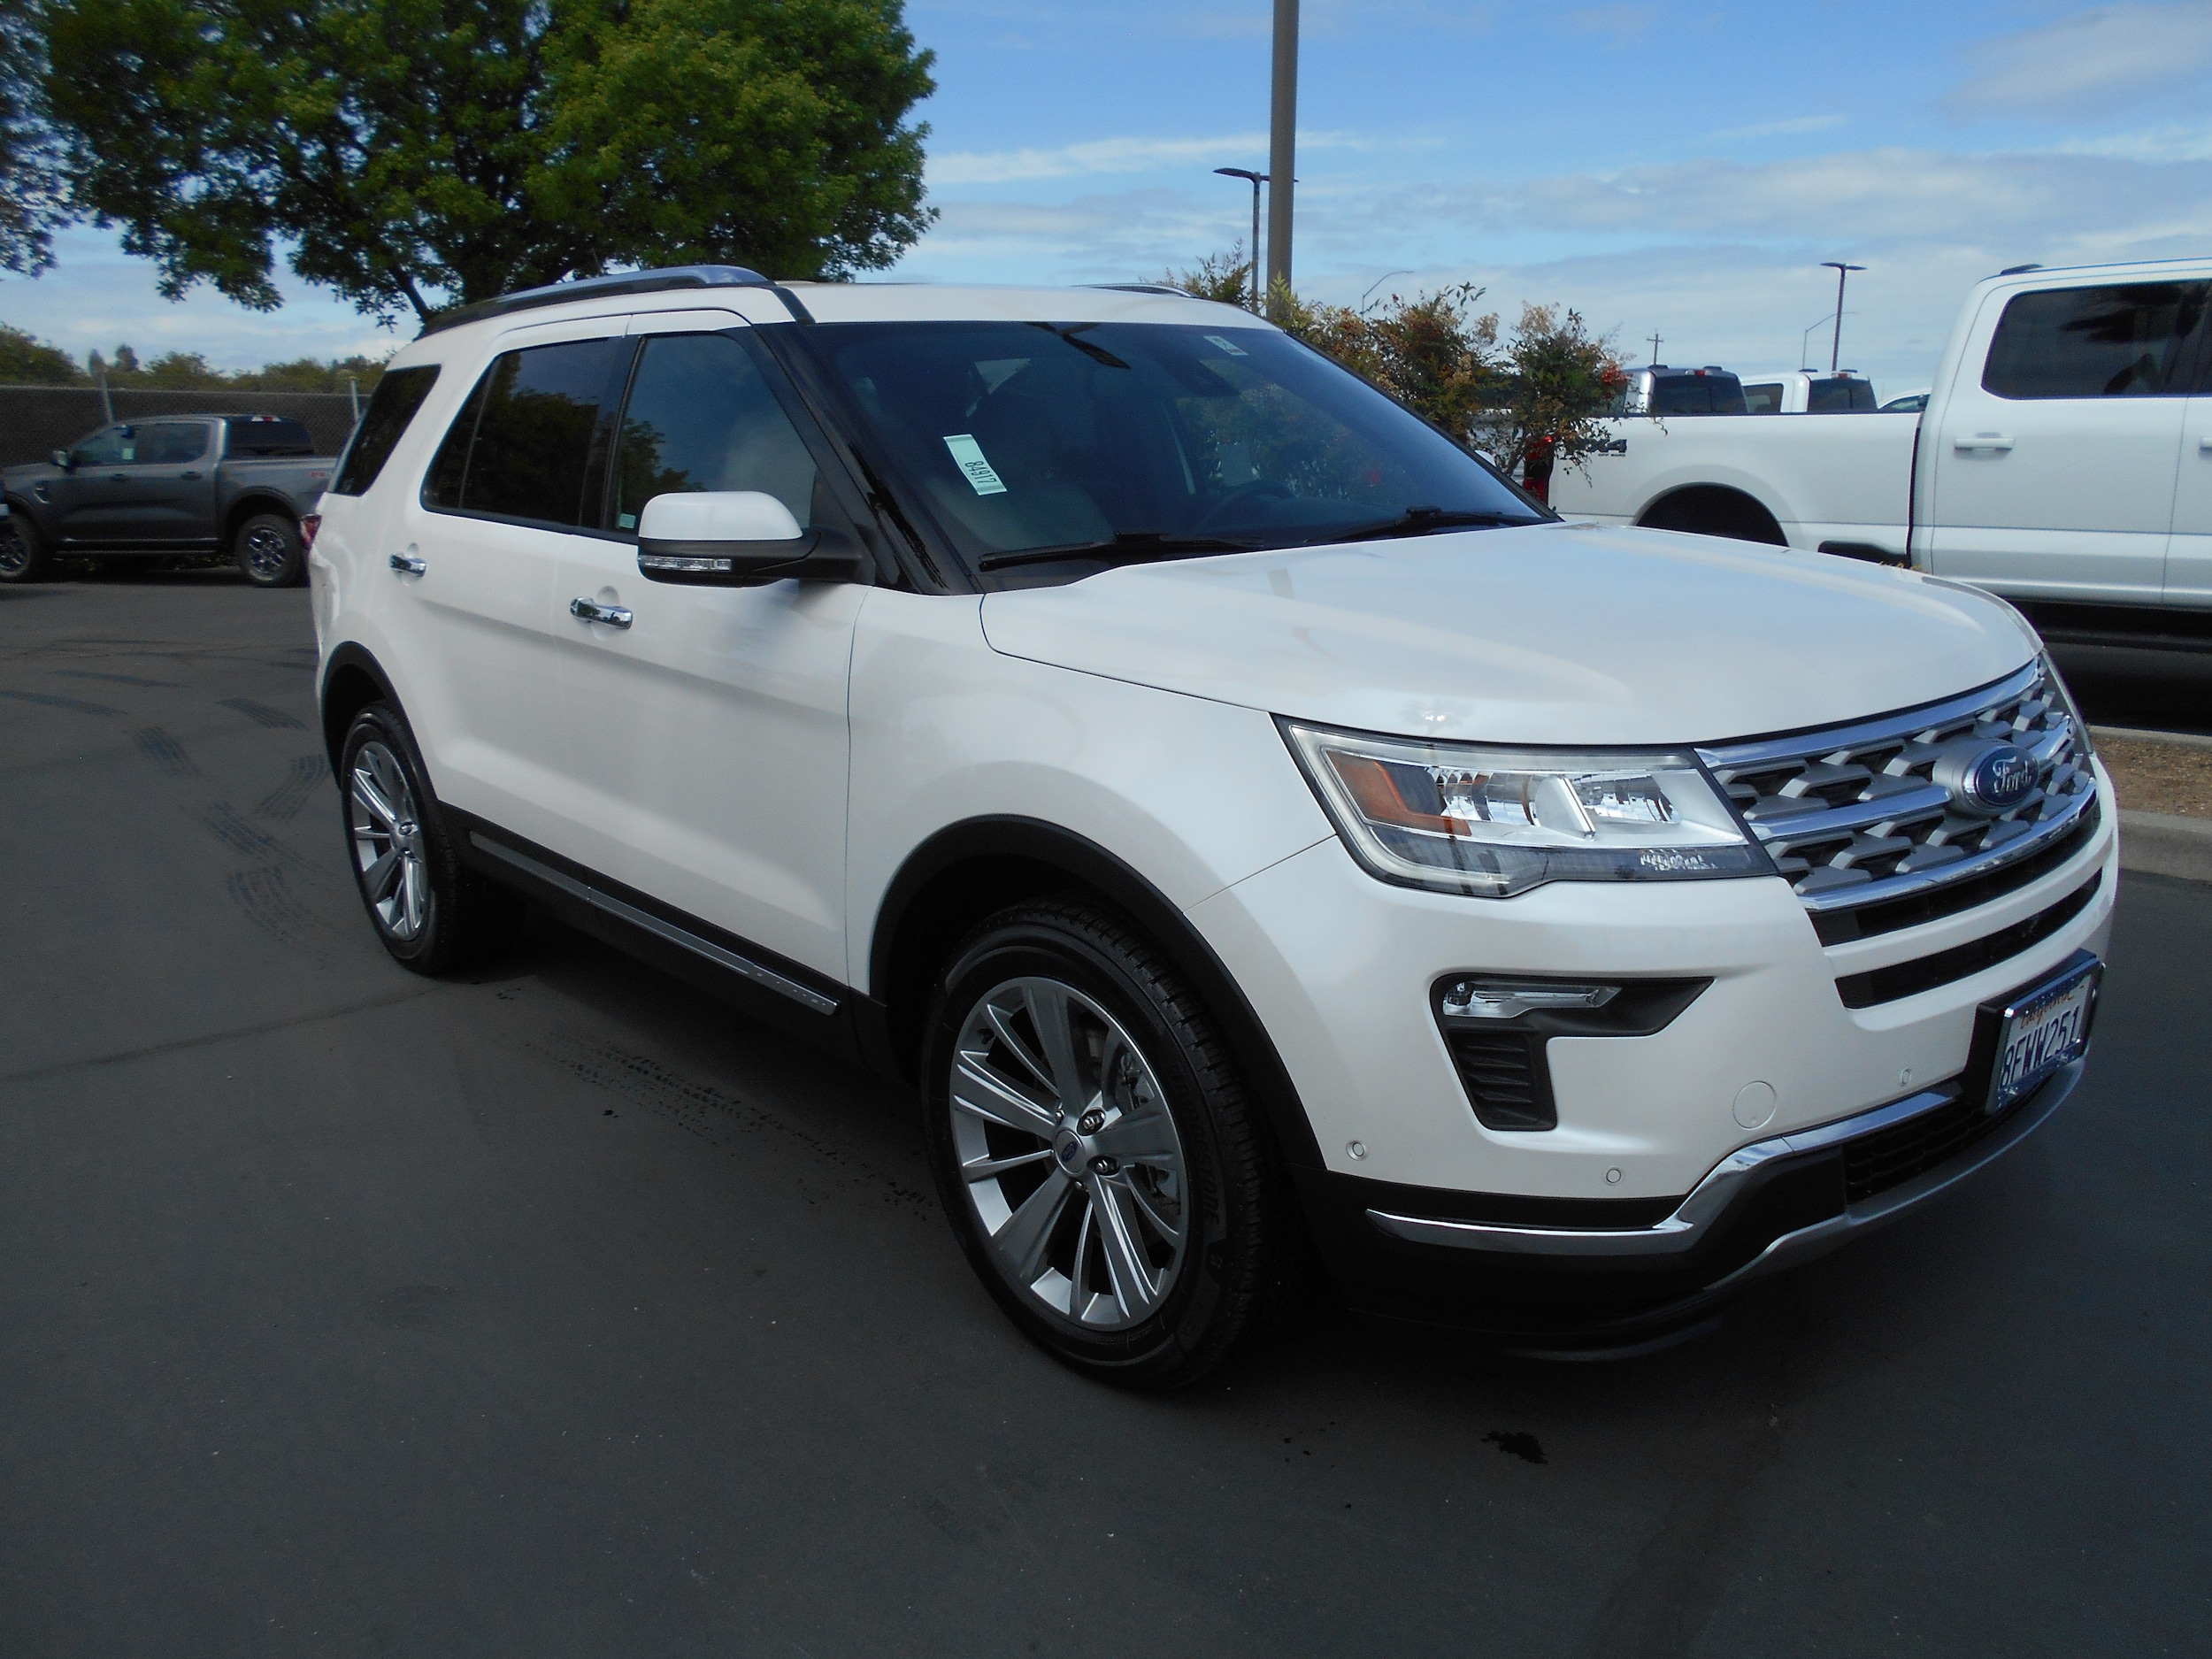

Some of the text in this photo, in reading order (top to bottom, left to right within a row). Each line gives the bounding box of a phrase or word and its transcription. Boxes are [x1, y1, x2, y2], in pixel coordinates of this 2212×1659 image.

[964, 460, 997, 484] 84917
[1993, 756, 2032, 795] Ford
[2000, 1005, 2081, 1091] 8FWW251
